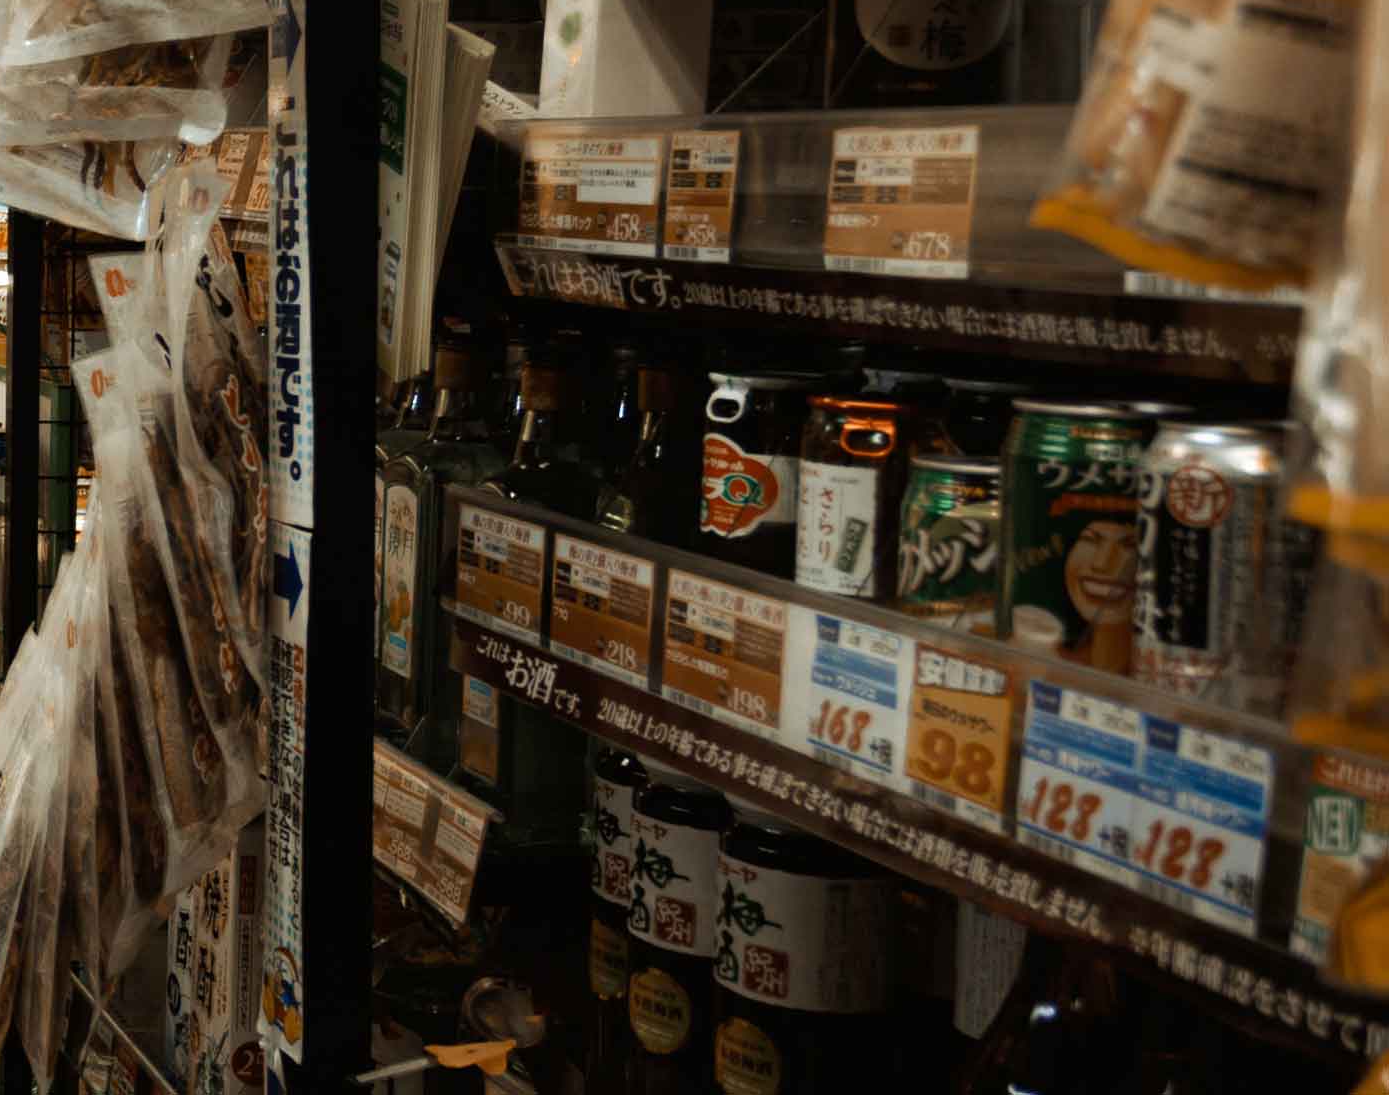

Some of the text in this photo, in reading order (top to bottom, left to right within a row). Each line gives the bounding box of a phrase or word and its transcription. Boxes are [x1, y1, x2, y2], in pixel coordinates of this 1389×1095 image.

[274, 91, 305, 485] これはお酒です。
[922, 728, 996, 803] 98
